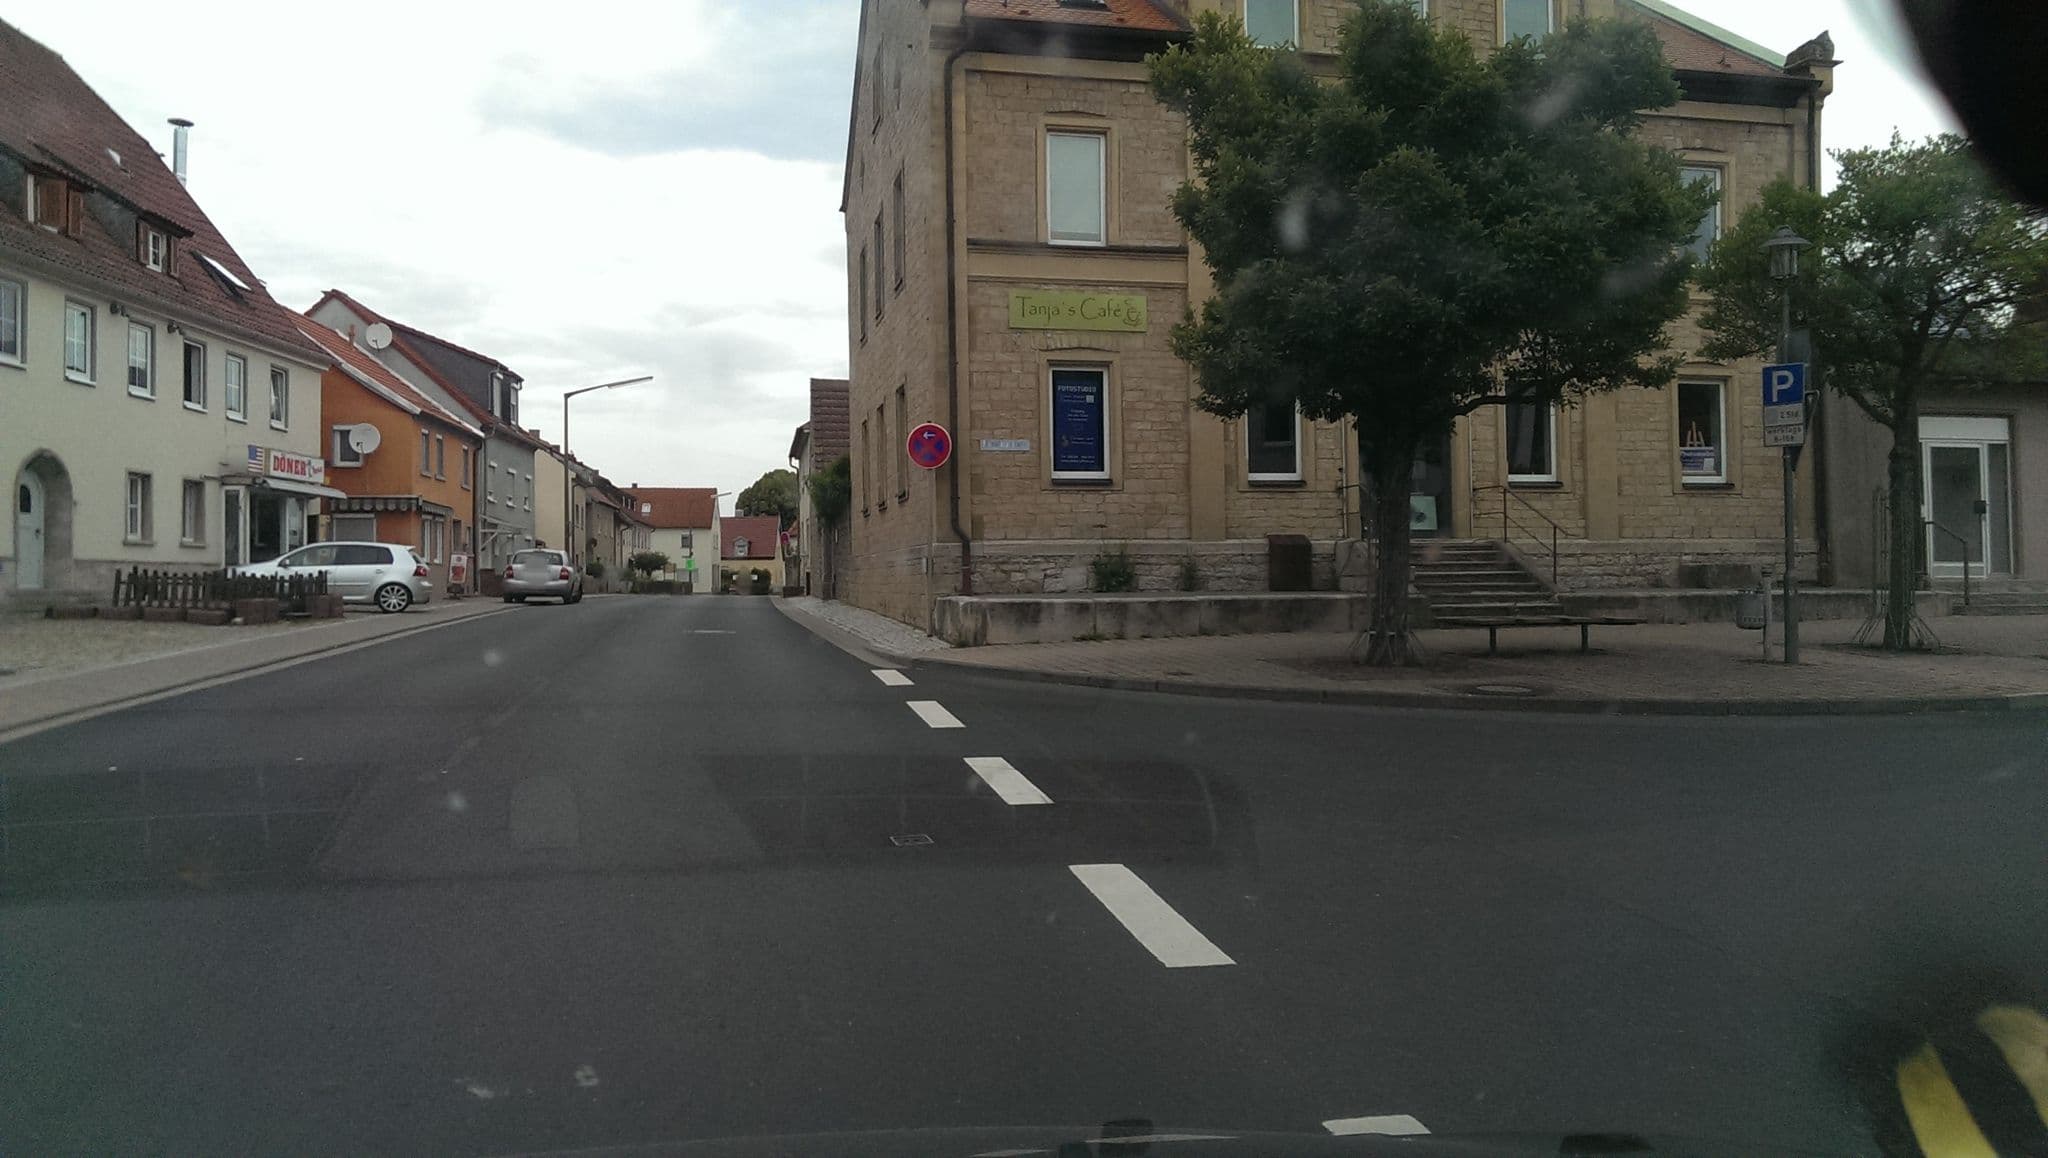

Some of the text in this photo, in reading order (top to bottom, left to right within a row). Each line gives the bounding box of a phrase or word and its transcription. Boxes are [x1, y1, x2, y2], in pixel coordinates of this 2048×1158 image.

[1015, 295, 1121, 324] Tanja's Café
[1772, 370, 1794, 402] P
[273, 453, 306, 476] DÖNER
